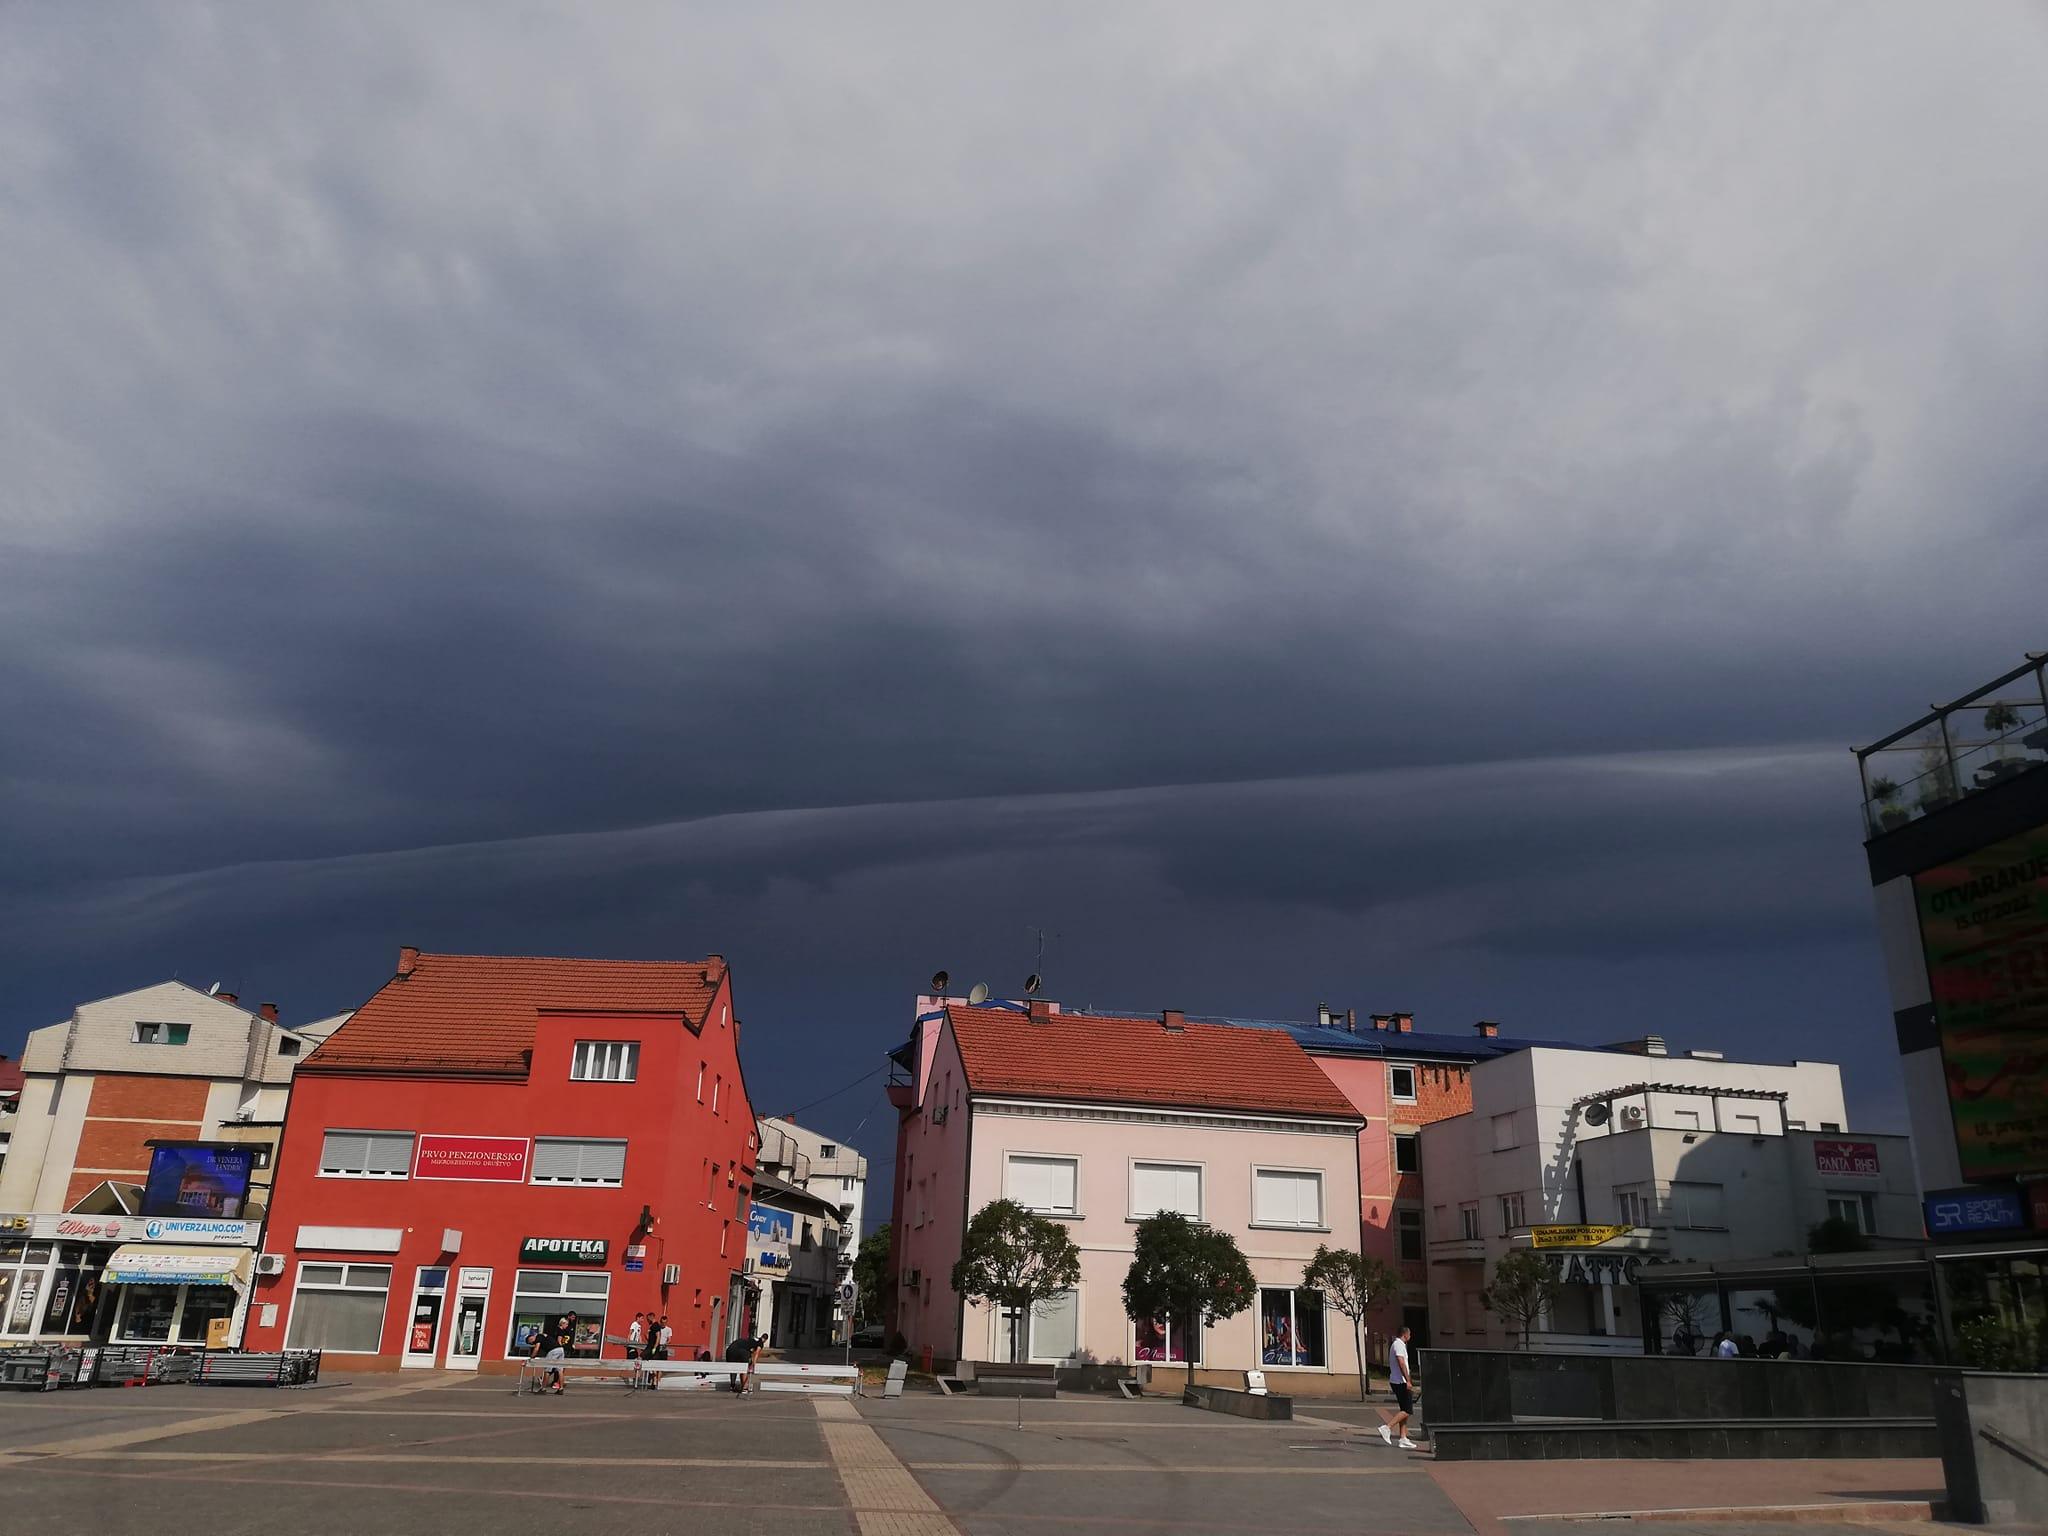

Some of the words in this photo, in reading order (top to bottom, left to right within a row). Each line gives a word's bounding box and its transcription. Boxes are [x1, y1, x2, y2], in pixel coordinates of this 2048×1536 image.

[421, 1150, 447, 1159] PRVO
[448, 1151, 523, 1161] PENZIONERSKO
[1819, 1156, 1852, 1170] PANTA
[1854, 1158, 1877, 1172] RHEI
[1966, 1199, 2004, 1213] SPORT
[1935, 1203, 1962, 1227] SR
[1967, 1209, 2015, 1224] REALITY
[165, 1222, 244, 1233] UNIVERZALNO.COM
[524, 1238, 605, 1253] APOTEKA
[1545, 1253, 1664, 1285] TATTO
